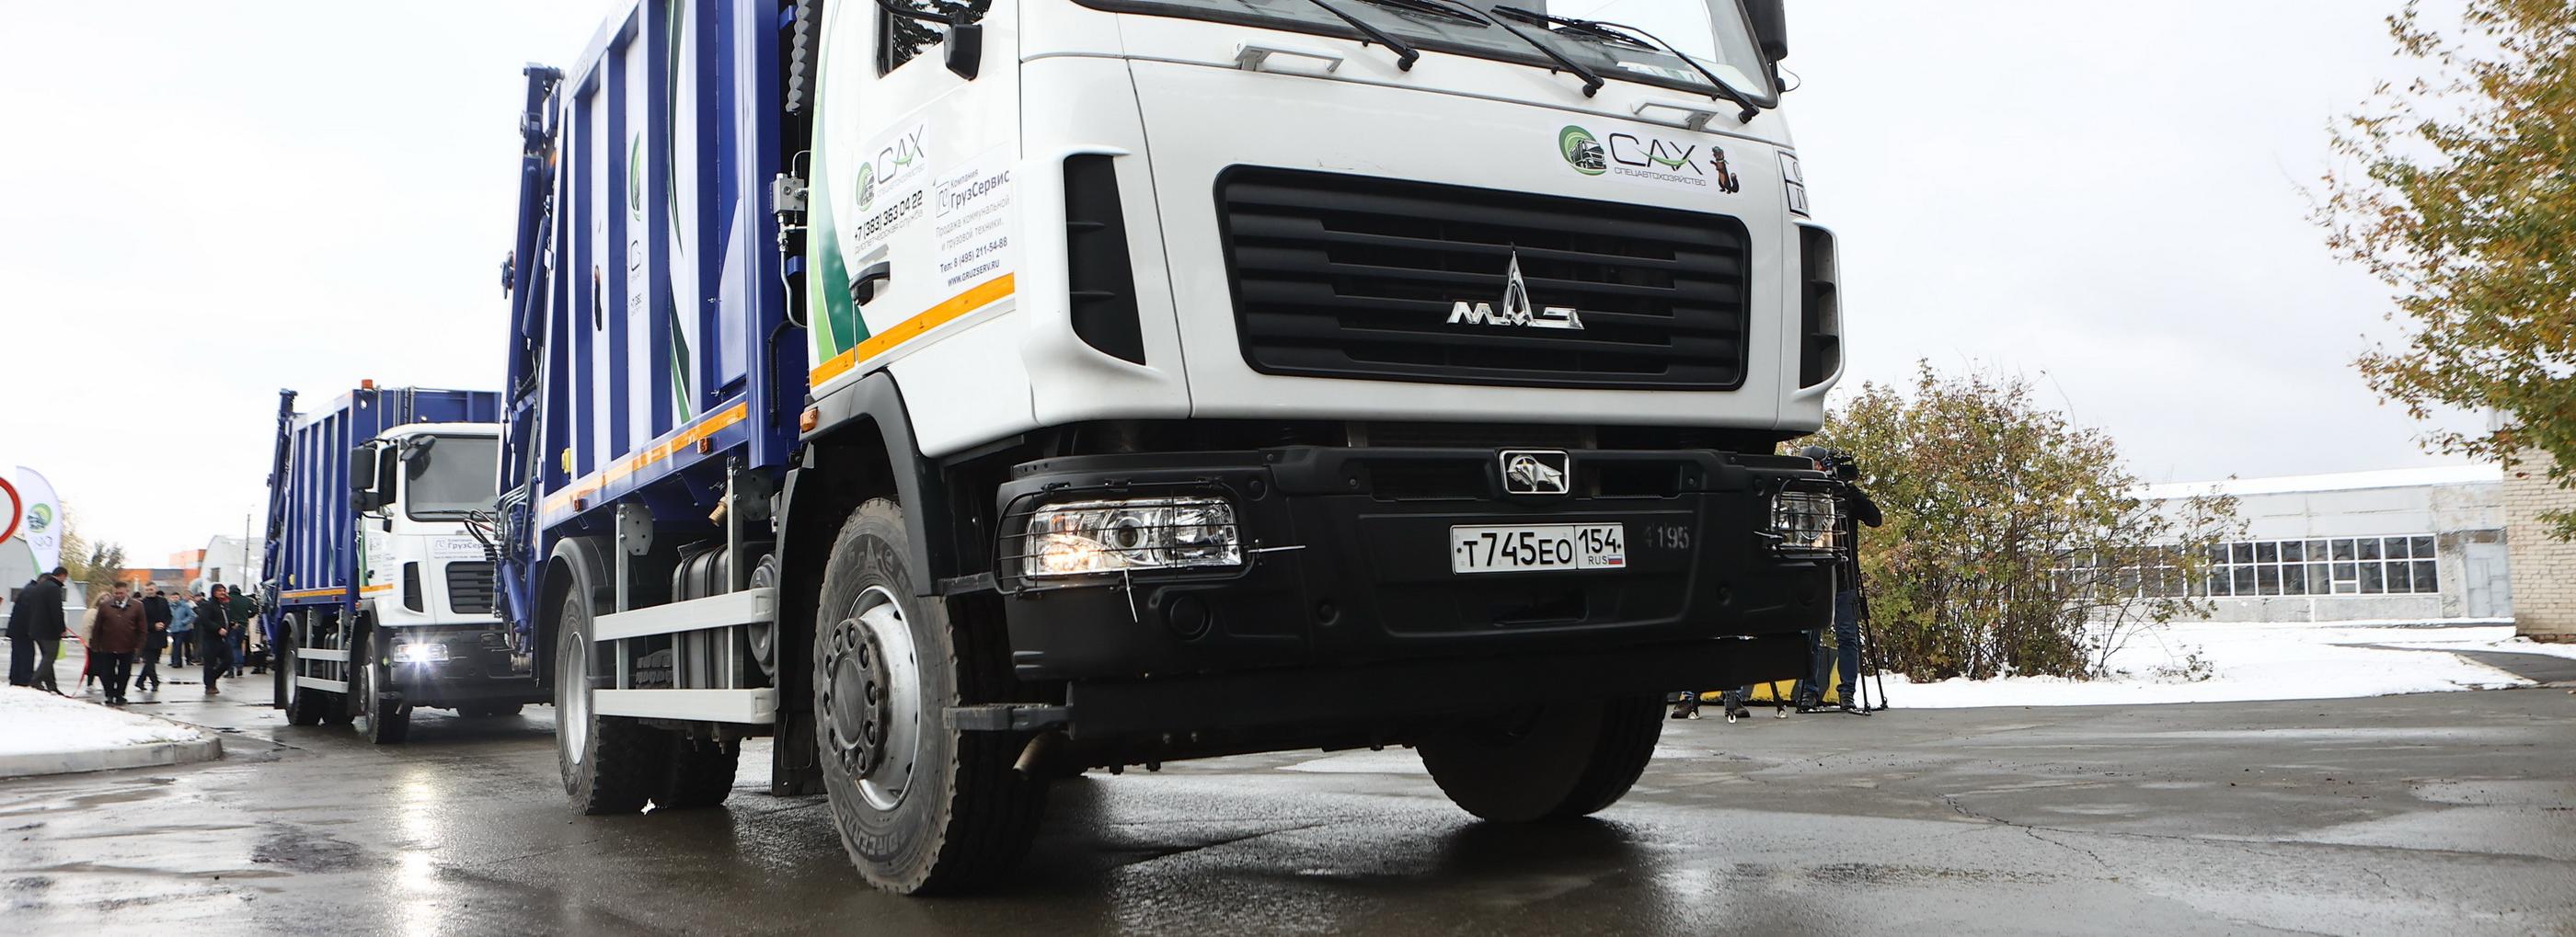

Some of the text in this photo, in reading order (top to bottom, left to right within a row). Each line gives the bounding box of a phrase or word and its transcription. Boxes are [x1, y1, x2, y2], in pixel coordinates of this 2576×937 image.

[1609, 132, 1704, 176] САХ
[950, 170, 1010, 210] ГрузСервис
[1615, 166, 1707, 187] СПЕЦАВТОХОЗЯЙСТВО
[864, 213, 881, 240] (383)
[883, 205, 898, 226] 363
[900, 197, 910, 217] 04
[912, 189, 923, 210] 22
[954, 257, 958, 268] 8
[959, 250, 975, 268] (495)
[976, 236, 1007, 258] 211-54-88
[1578, 528, 1617, 554] 154
[1588, 555, 1607, 565] RUS
